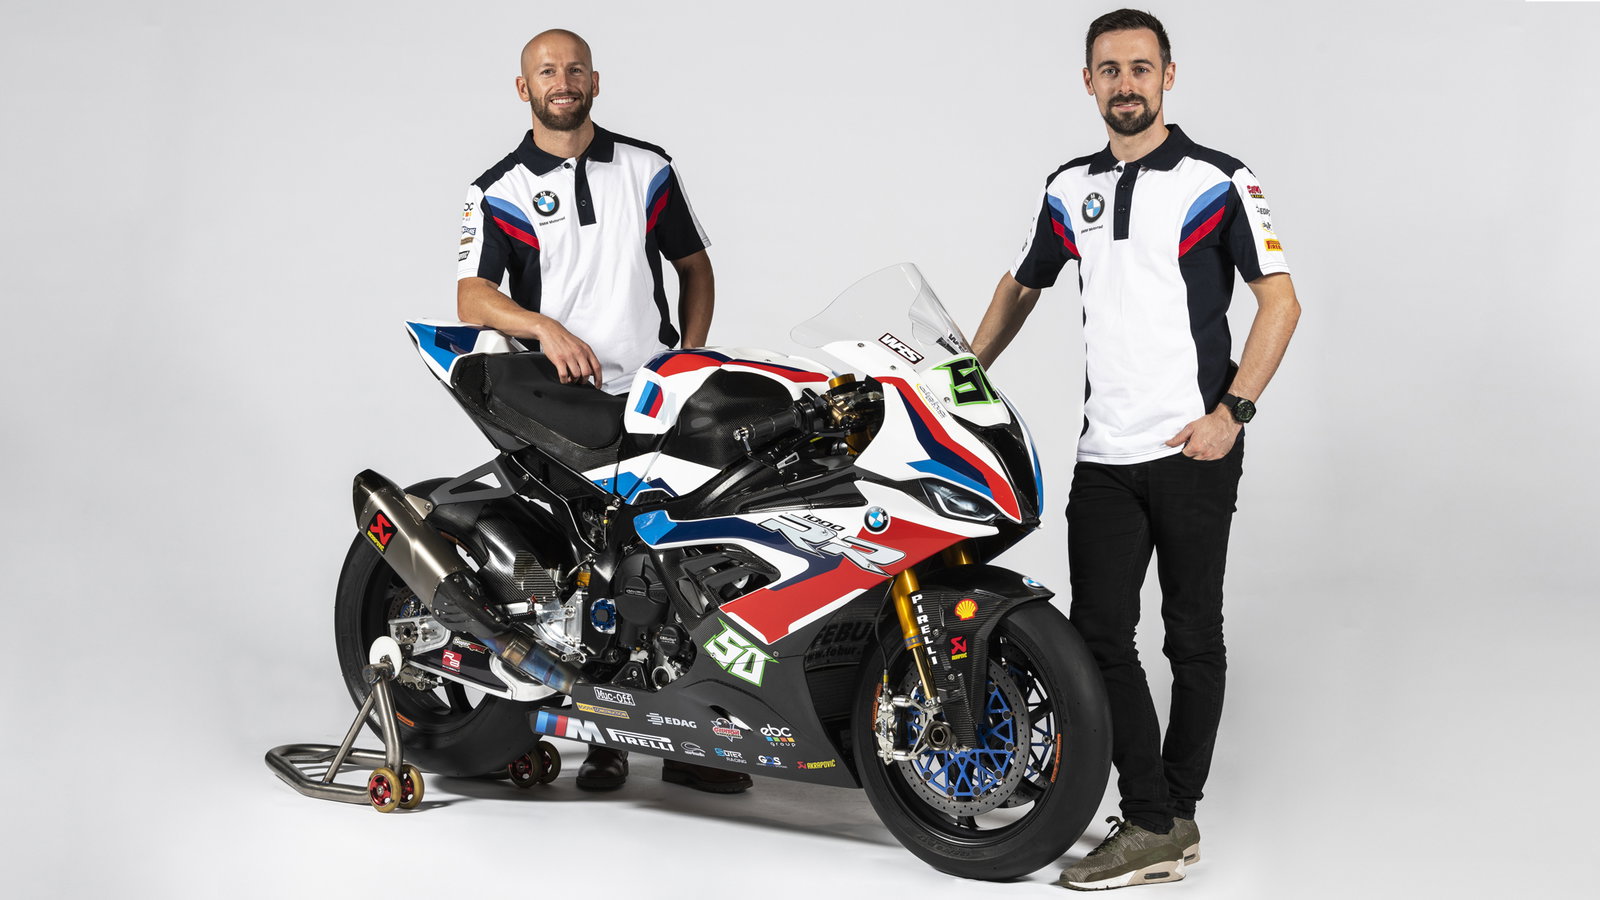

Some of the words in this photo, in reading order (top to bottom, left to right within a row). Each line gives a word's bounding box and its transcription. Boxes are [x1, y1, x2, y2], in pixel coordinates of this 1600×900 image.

[881, 334, 922, 362] WRS
[803, 513, 846, 532] 1000
[911, 593, 938, 666] PIRELLI
[703, 617, 779, 688] 50
[596, 689, 632, 705] Muc-Off
[565, 716, 606, 744] M
[664, 716, 697, 729] EDAG
[760, 723, 792, 737] ebc
[606, 727, 675, 752] PIRELLI
[726, 756, 748, 764] RACING
